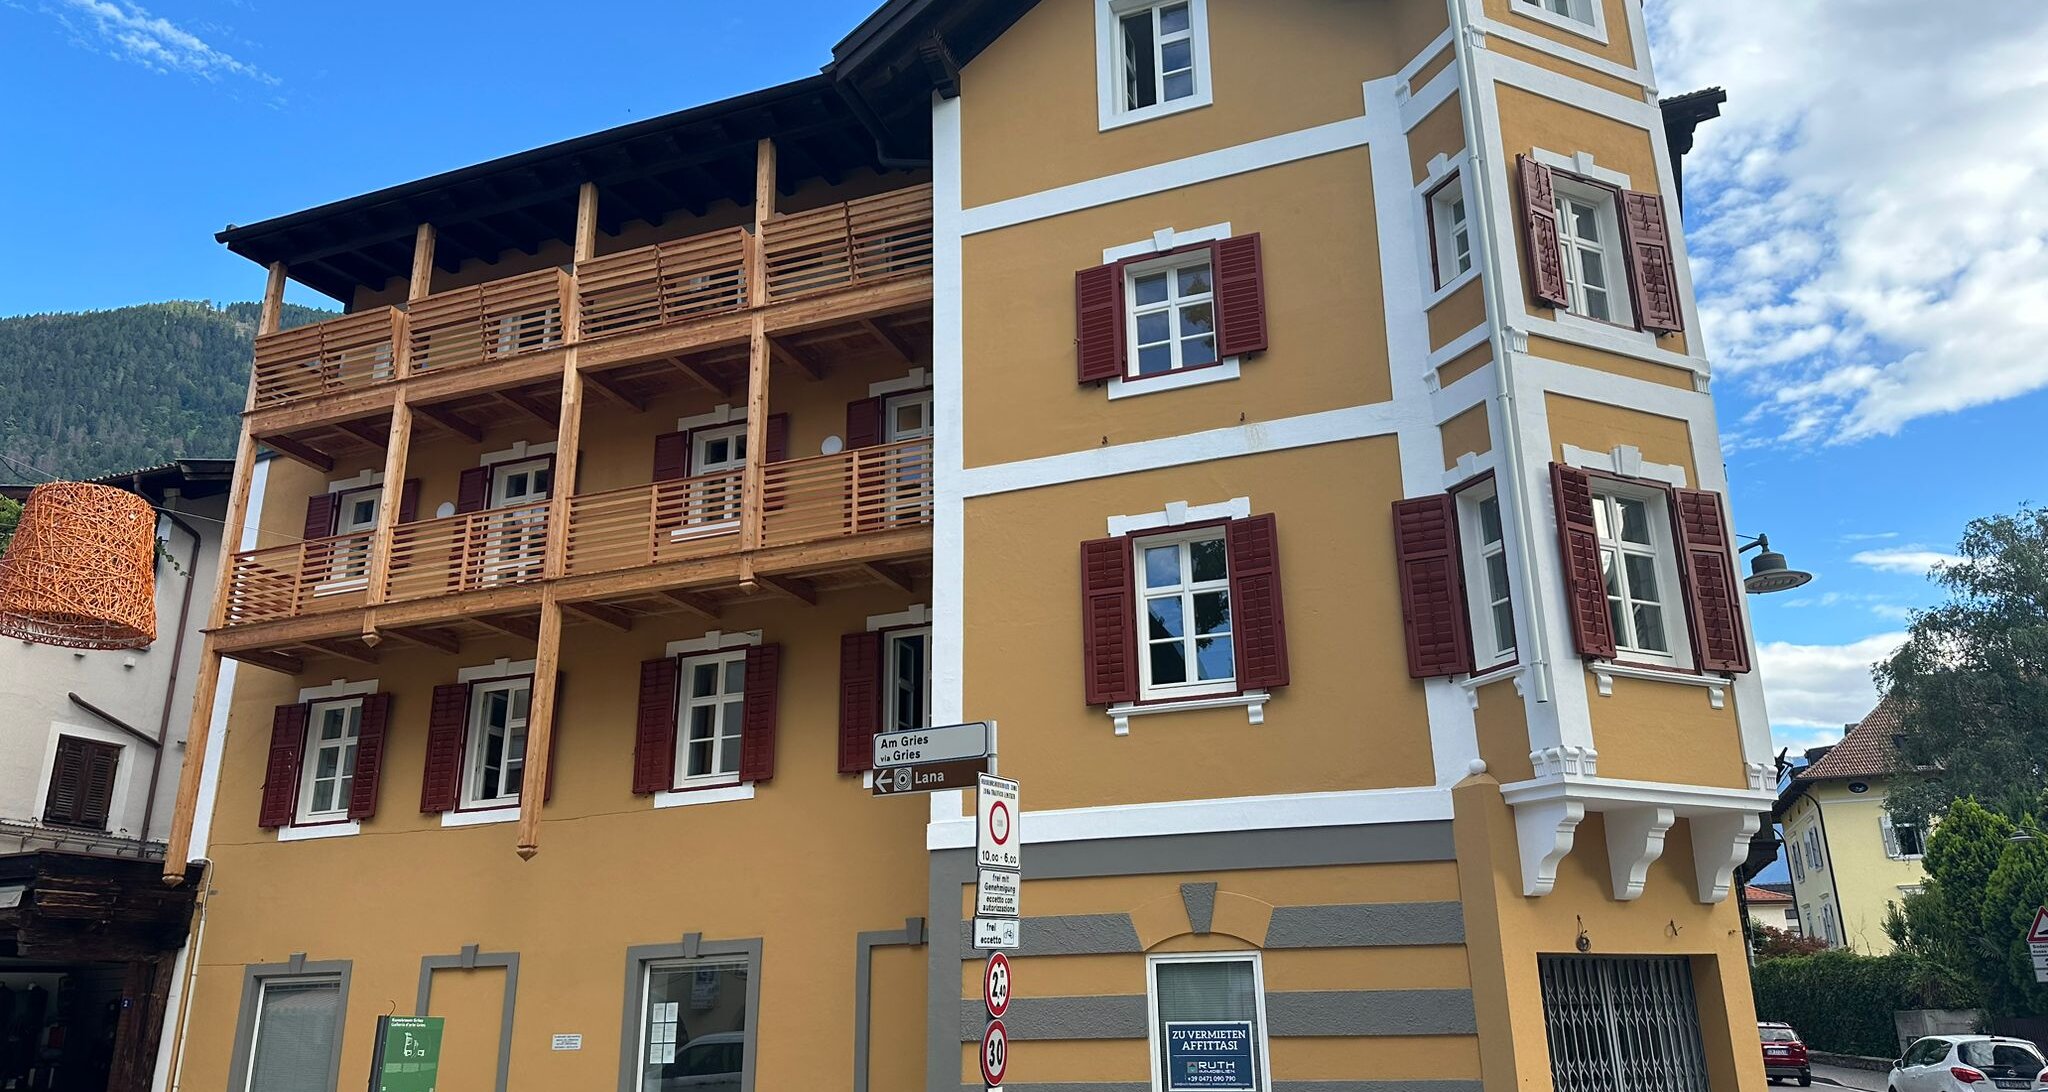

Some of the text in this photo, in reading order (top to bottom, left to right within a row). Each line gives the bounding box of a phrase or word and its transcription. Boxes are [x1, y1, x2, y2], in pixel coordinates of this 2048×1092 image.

[881, 735, 929, 749] Am Gries
[880, 749, 921, 763] via Gries
[915, 771, 945, 784] Lana
[992, 873, 1000, 882] frei
[984, 882, 1015, 894] Genehmigung
[986, 896, 1004, 904] eccetto
[986, 922, 997, 932] frei
[980, 936, 1002, 945] eccetto
[1172, 1030, 1246, 1039] ZU VERMIETEN
[1182, 1041, 1238, 1050] AFFITTASI
[989, 1039, 1003, 1067] 30
[1198, 1061, 1235, 1069] RUTH
